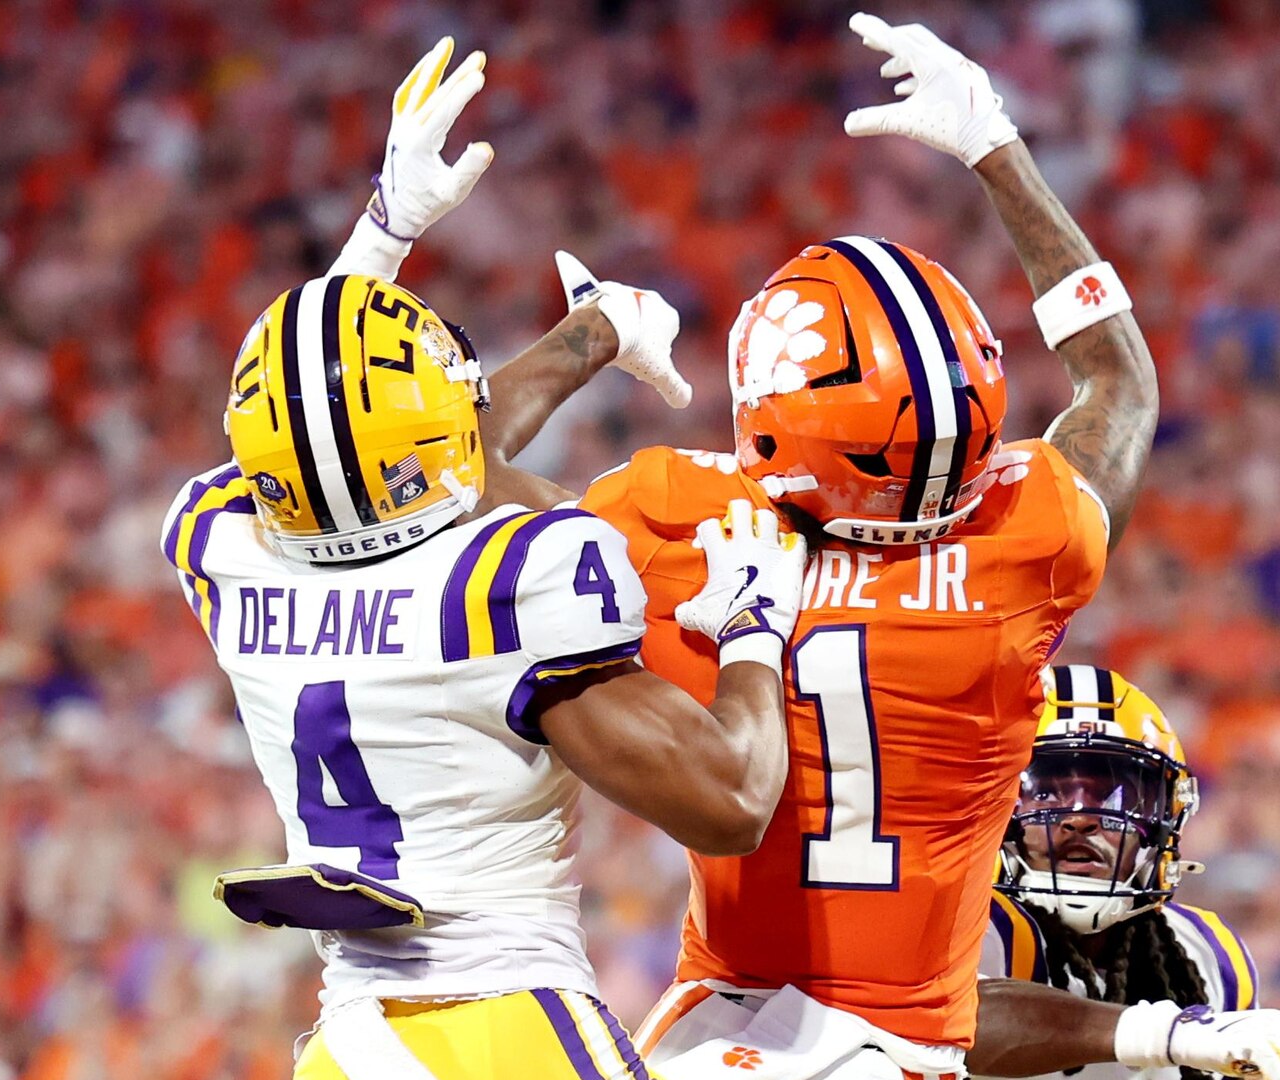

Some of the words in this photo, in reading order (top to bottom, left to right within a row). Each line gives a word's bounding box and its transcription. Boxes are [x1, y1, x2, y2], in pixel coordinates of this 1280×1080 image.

[369, 290, 420, 375] LS
[260, 476, 276, 490] 20
[379, 499, 391, 513] 4
[945, 494, 954, 509] 1
[304, 524, 424, 558] TIGERS
[851, 524, 949, 543] CLEMS
[573, 541, 621, 624] 4
[899, 543, 984, 612] JR.
[238, 587, 414, 656] DELANE
[1066, 721, 1106, 734] LSU
[291, 679, 404, 881] 4
[792, 624, 900, 891] 1
